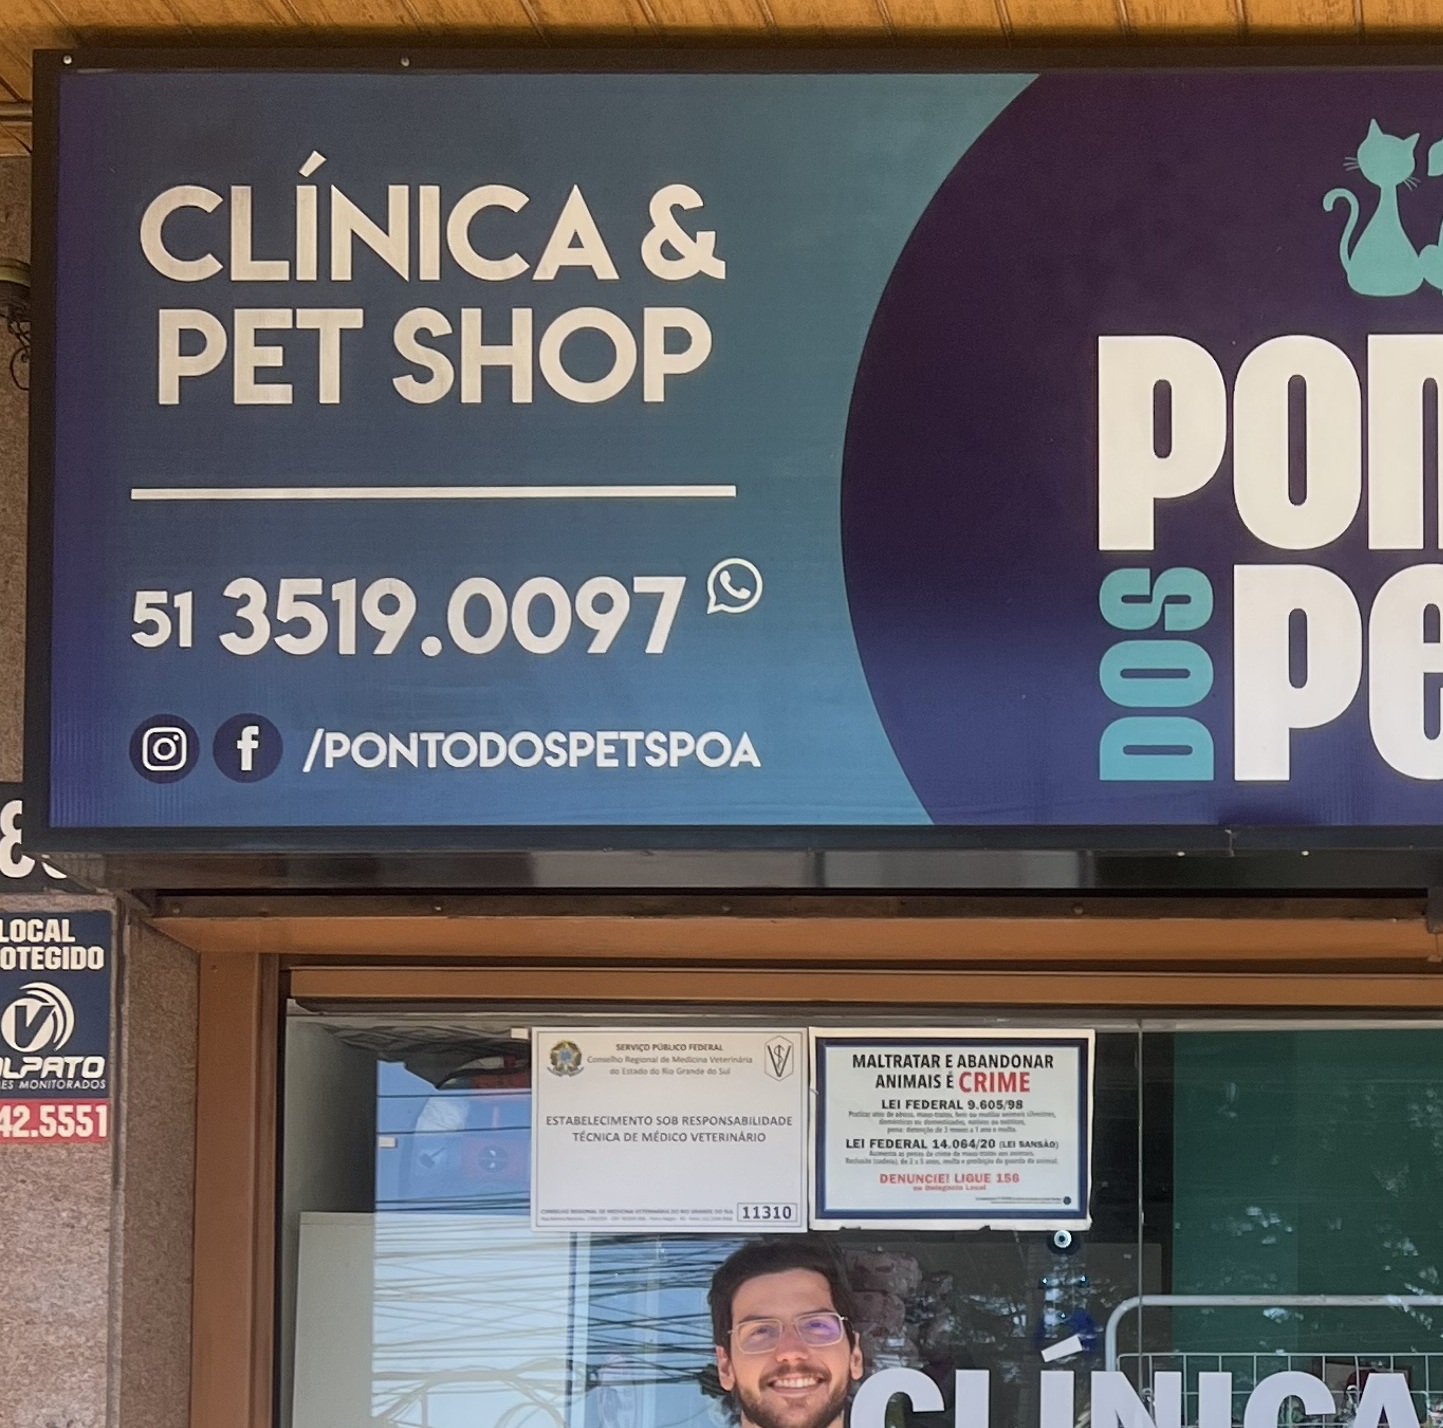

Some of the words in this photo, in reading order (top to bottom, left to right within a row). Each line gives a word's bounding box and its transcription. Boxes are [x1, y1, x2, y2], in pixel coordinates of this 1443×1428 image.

[140, 150, 619, 282] CLÍNICA
[641, 184, 726, 281] &
[158, 308, 364, 404] PET
[392, 306, 713, 404] SHOP
[131, 591, 192, 648] 51
[219, 577, 686, 656] 3519.0097
[1099, 568, 1214, 781] DOS
[302, 729, 762, 773] /PONTODOSPETSPOA
[616, 1043, 650, 1052] SERVIÇO
[652, 1043, 687, 1051] PÚBLICO
[688, 1043, 723, 1051] FEDERAL
[587, 1056, 623, 1064] Conselho
[625, 1056, 658, 1065] Regional
[660, 1056, 670, 1064] de
[672, 1056, 708, 1064] Medicina
[709, 1056, 753, 1064] Veterinária
[852, 1054, 941, 1069] MALTRATAR
[945, 1054, 953, 1068] E
[957, 1054, 1054, 1069] ABANDONAR
[19, 1080, 106, 1090] MONITORADOS
[875, 1074, 941, 1089] ANIMAIS
[946, 1071, 954, 1089] É
[958, 1071, 1031, 1093] CRIME
[881, 1099, 901, 1110] LEI
[905, 1099, 964, 1110] FEDERAL
[967, 1099, 1023, 1110] 9.605/98
[546, 1116, 653, 1126] ESTABELECIMENTO
[656, 1116, 679, 1126] SOB
[682, 1116, 793, 1126] RESPONSABILIDADE
[572, 1131, 620, 1143] TÉCNICA
[624, 1133, 637, 1142] DE
[641, 1131, 687, 1142] MÉDICO
[691, 1131, 766, 1142] VETERINÁRIO
[845, 1139, 865, 1149] LEI
[869, 1139, 928, 1149] FEDERAL
[932, 1139, 996, 1149] 14.064/20
[879, 1173, 950, 1184] DENUNCIE!
[954, 1173, 991, 1184] LIGUE
[996, 1173, 1020, 1183] 156
[742, 1206, 792, 1220] 11310
